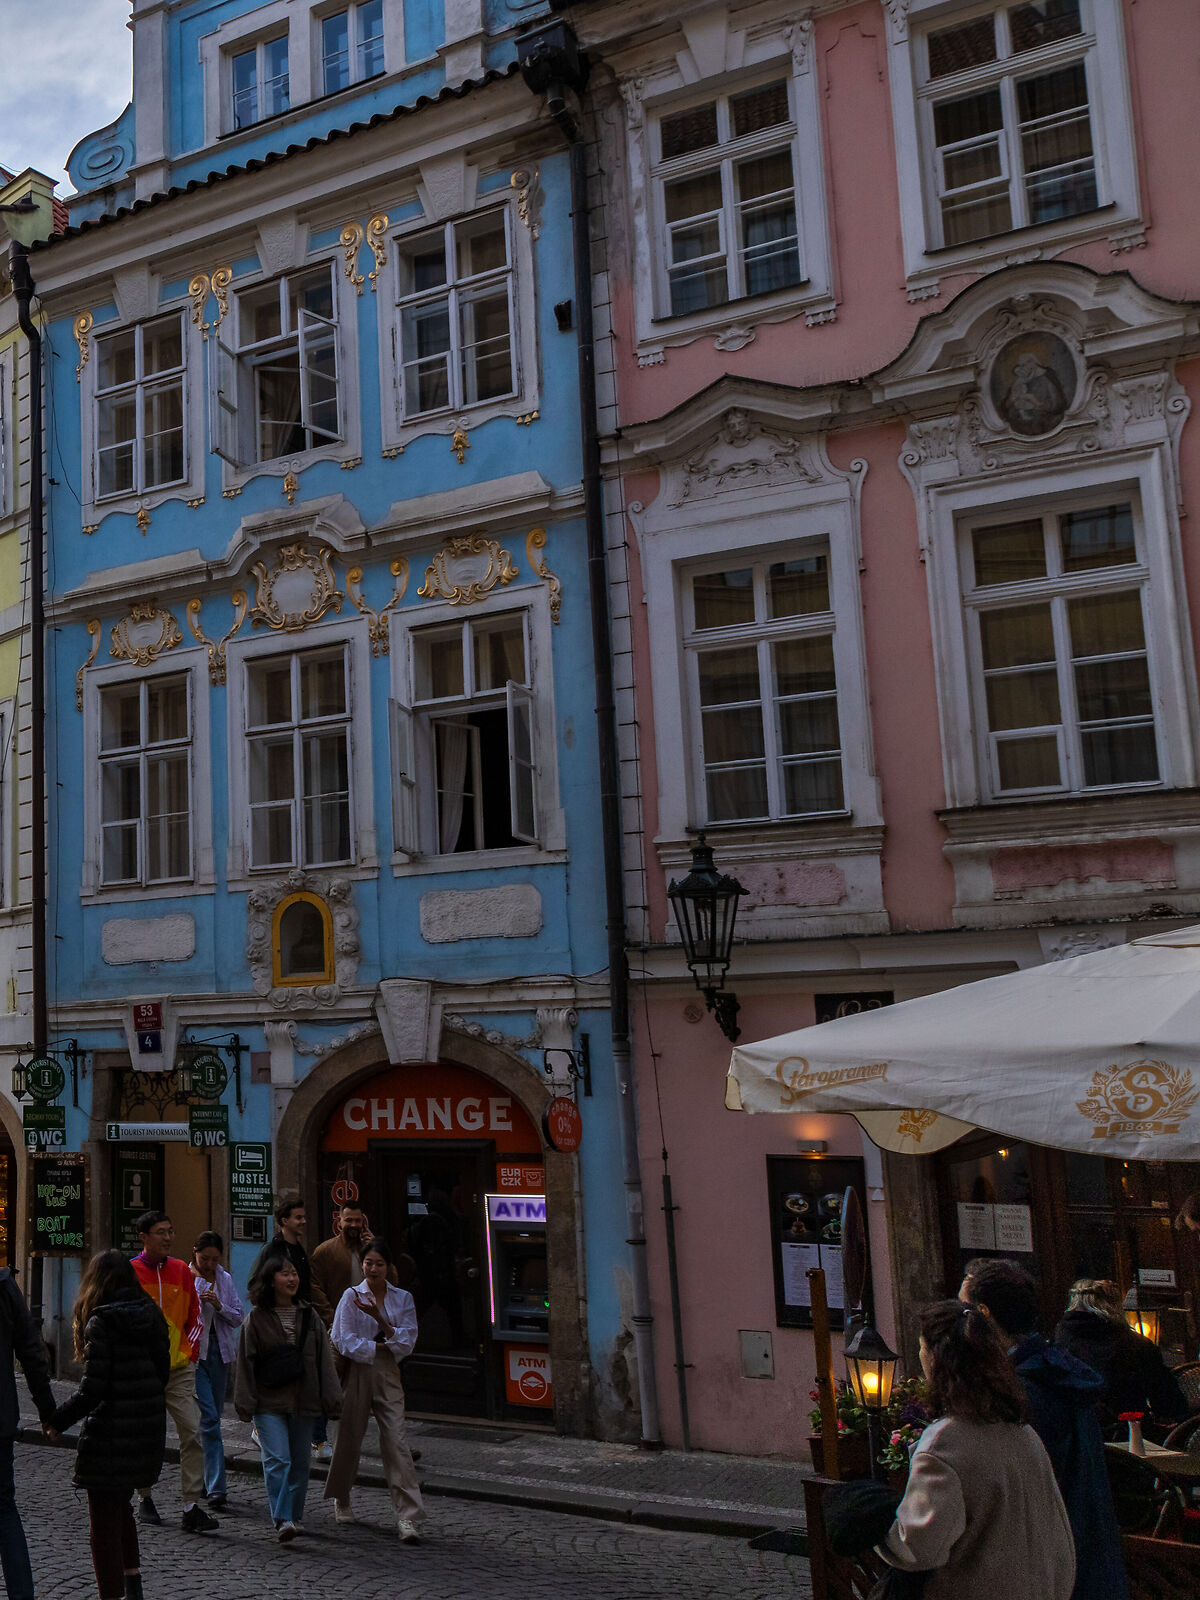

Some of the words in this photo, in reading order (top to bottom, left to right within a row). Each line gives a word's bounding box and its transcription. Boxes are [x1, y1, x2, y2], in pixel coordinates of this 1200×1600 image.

[140, 1005, 153, 1017] 53
[144, 1035, 153, 1048] 4
[28, 1059, 49, 1072] TOURIST
[193, 1055, 213, 1069] TOURIST
[775, 1056, 888, 1104] Staropramen
[343, 1097, 513, 1132] CHANGE
[551, 1102, 577, 1119] change
[558, 1116, 572, 1134] 0%
[1119, 1122, 1153, 1131] 1869
[39, 1130, 63, 1145] WC
[121, 1128, 145, 1136] TOURIST
[146, 1128, 188, 1136] INFORMATION
[204, 1130, 226, 1146] WC
[231, 1172, 270, 1185] HOSTEL
[500, 1168, 521, 1177] EUR
[501, 1177, 522, 1186] CZK
[232, 1186, 252, 1194] CHARLES
[495, 1202, 546, 1218] ATM
[36, 1215, 71, 1232] BOAT
[48, 1232, 84, 1248] TOURS
[517, 1357, 546, 1368] ATM
